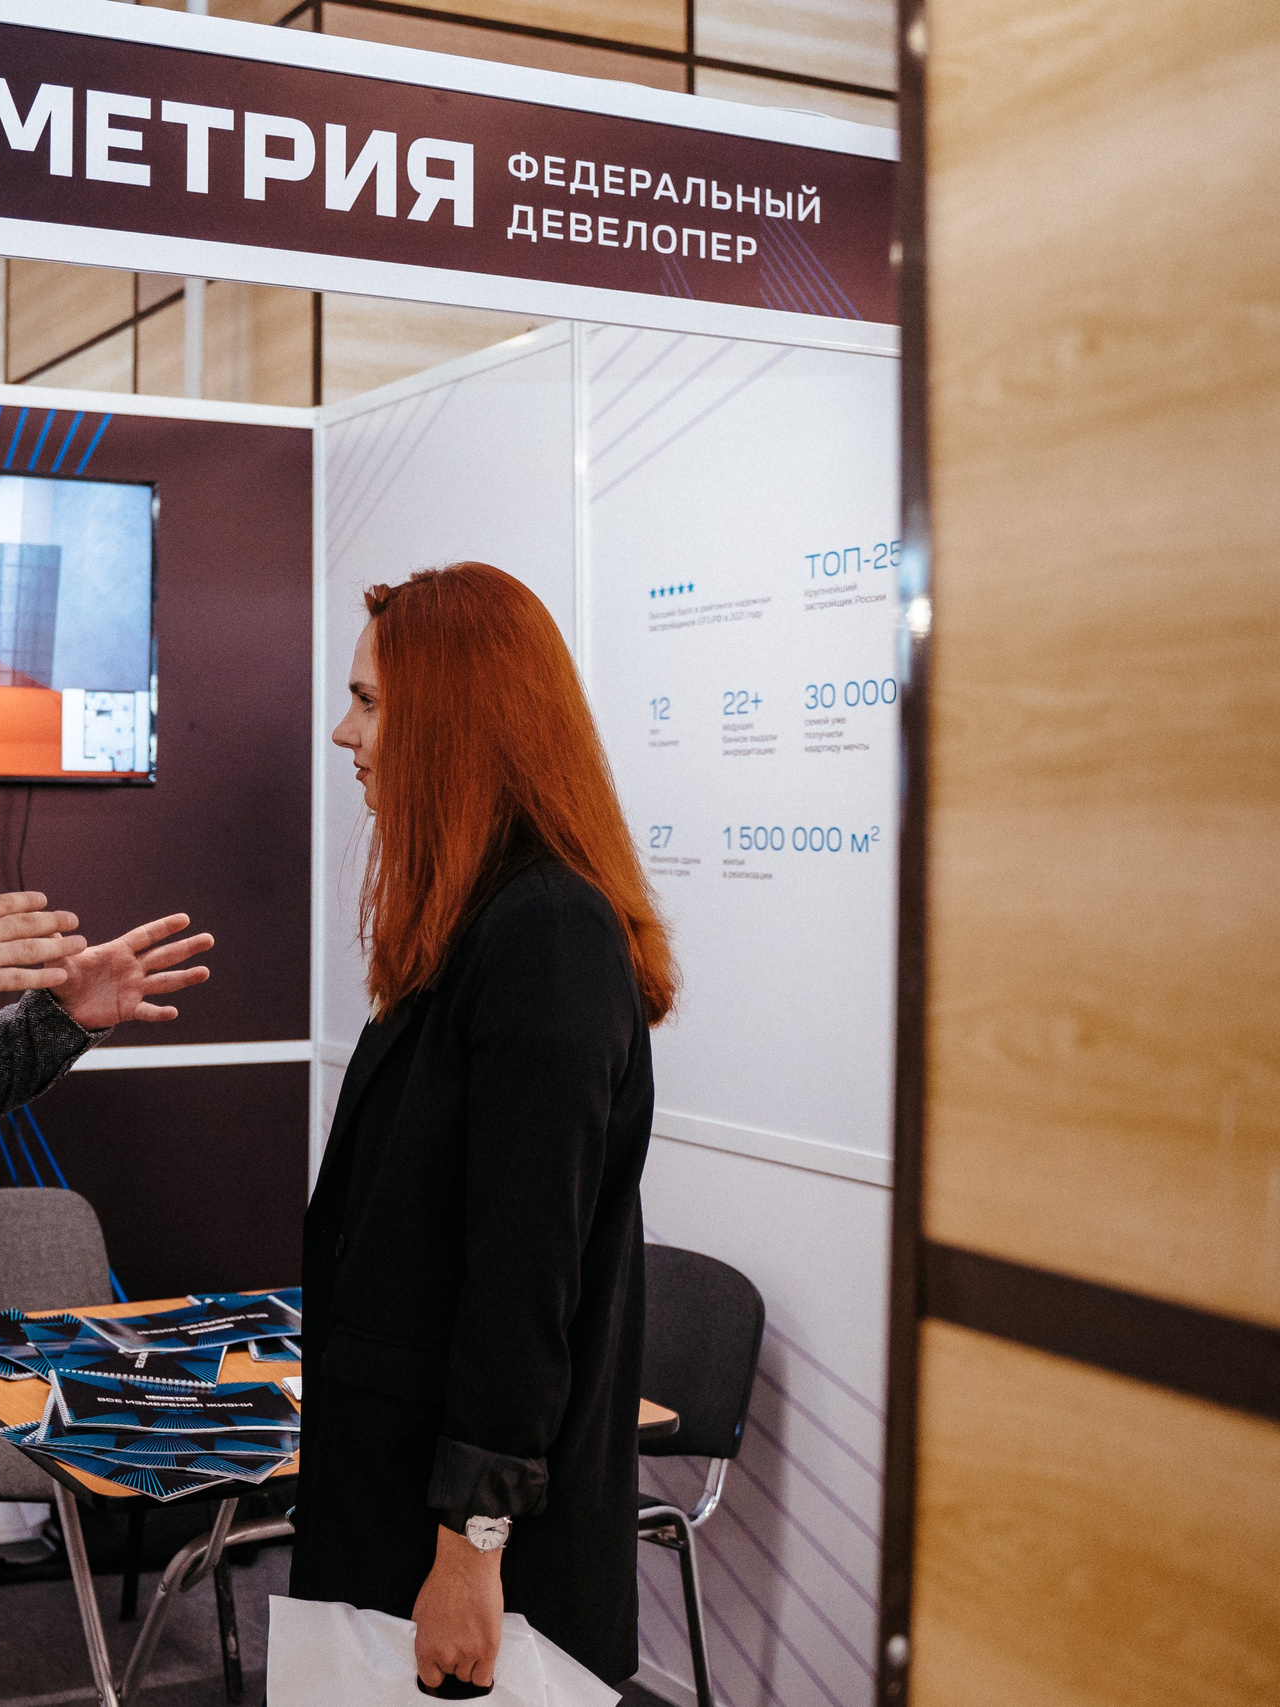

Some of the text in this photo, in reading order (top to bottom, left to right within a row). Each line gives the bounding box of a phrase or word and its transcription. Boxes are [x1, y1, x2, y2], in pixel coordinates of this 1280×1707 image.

[507, 150, 823, 226] ФЕДЕРАЛЬНЫЙ
[507, 202, 760, 264] ДЕВЕЛОПЕР
[722, 690, 763, 716] 22+
[804, 678, 898, 711] 30 000
[648, 696, 671, 721] 12
[649, 825, 673, 849] 27
[791, 826, 843, 853] 000
[125, 1399, 204, 1408] ИЗМЕРЕНИЯ
